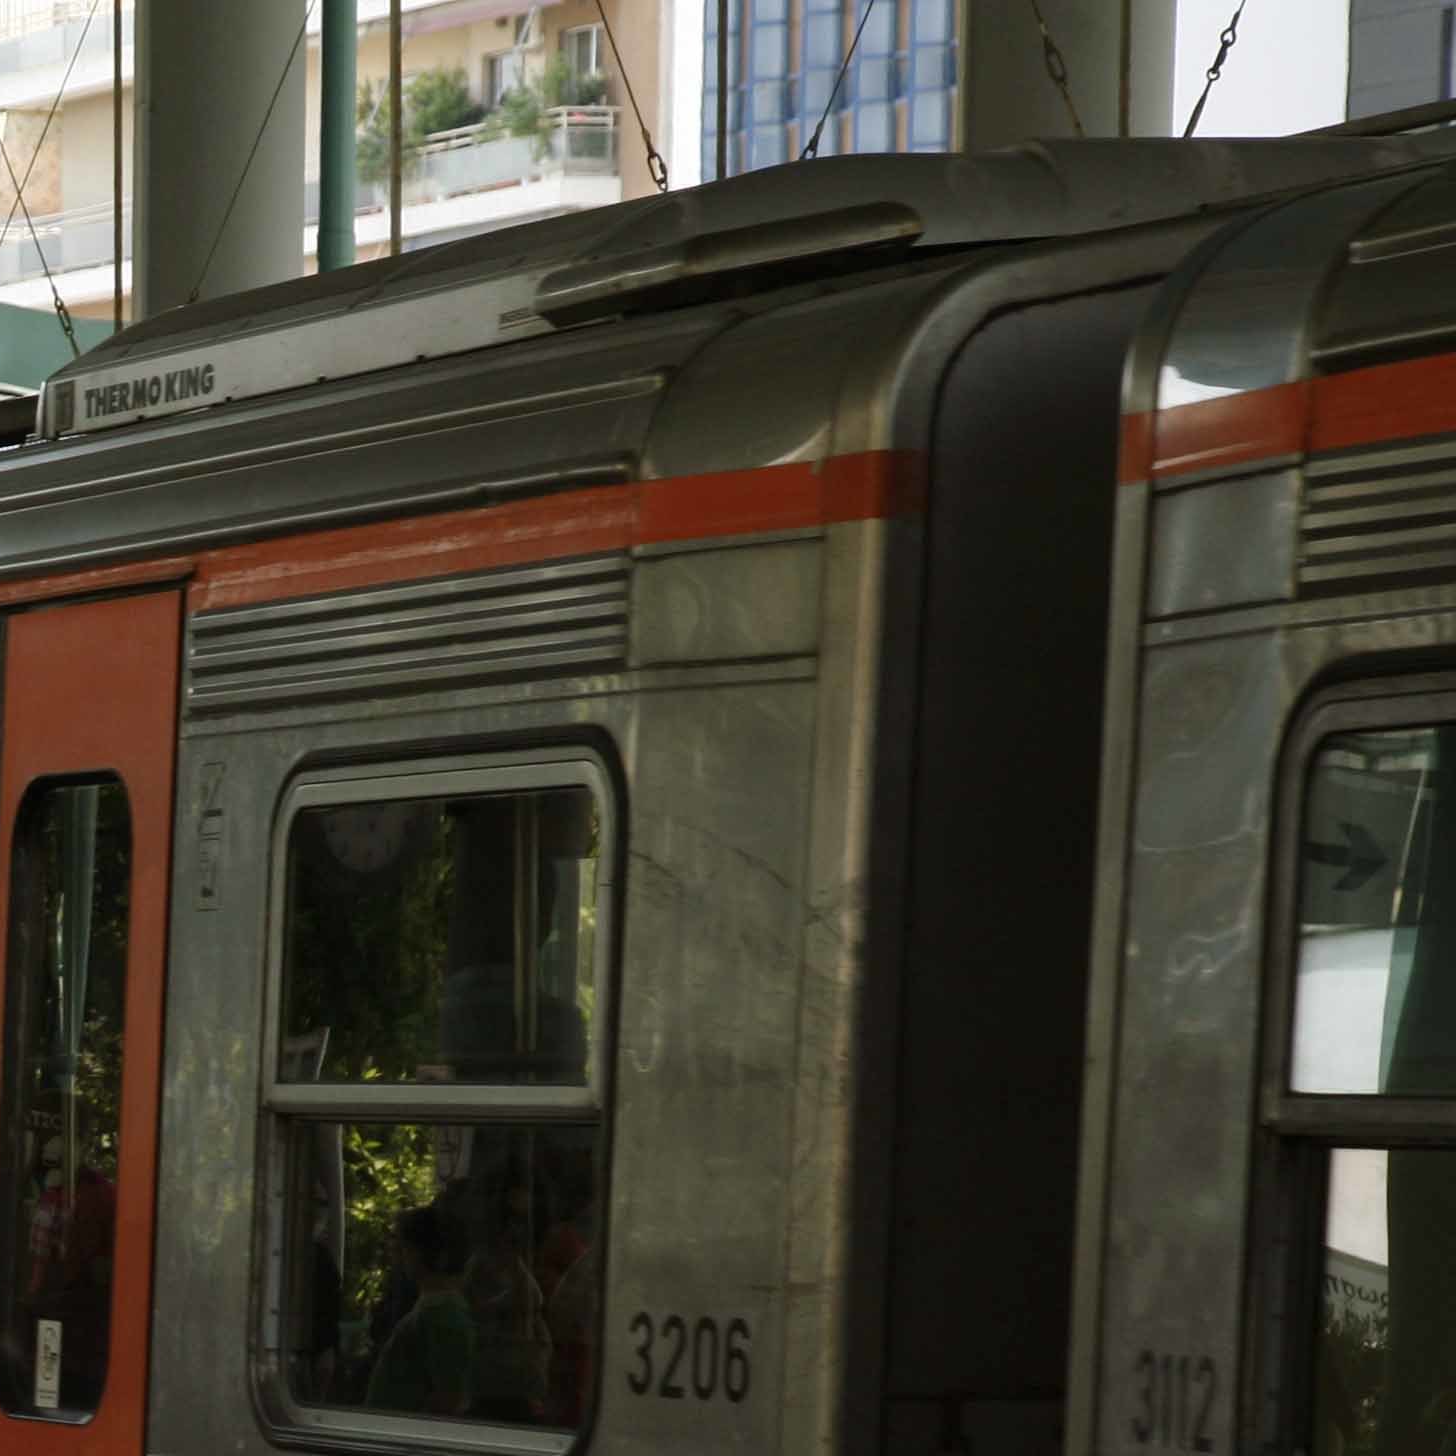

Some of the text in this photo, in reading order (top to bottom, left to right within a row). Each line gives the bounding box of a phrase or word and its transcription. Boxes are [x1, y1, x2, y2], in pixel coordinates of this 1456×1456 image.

[85, 364, 215, 418] THERMO KING
[626, 1311, 751, 1403] 3206
[1129, 1349, 1216, 1453] 3112
